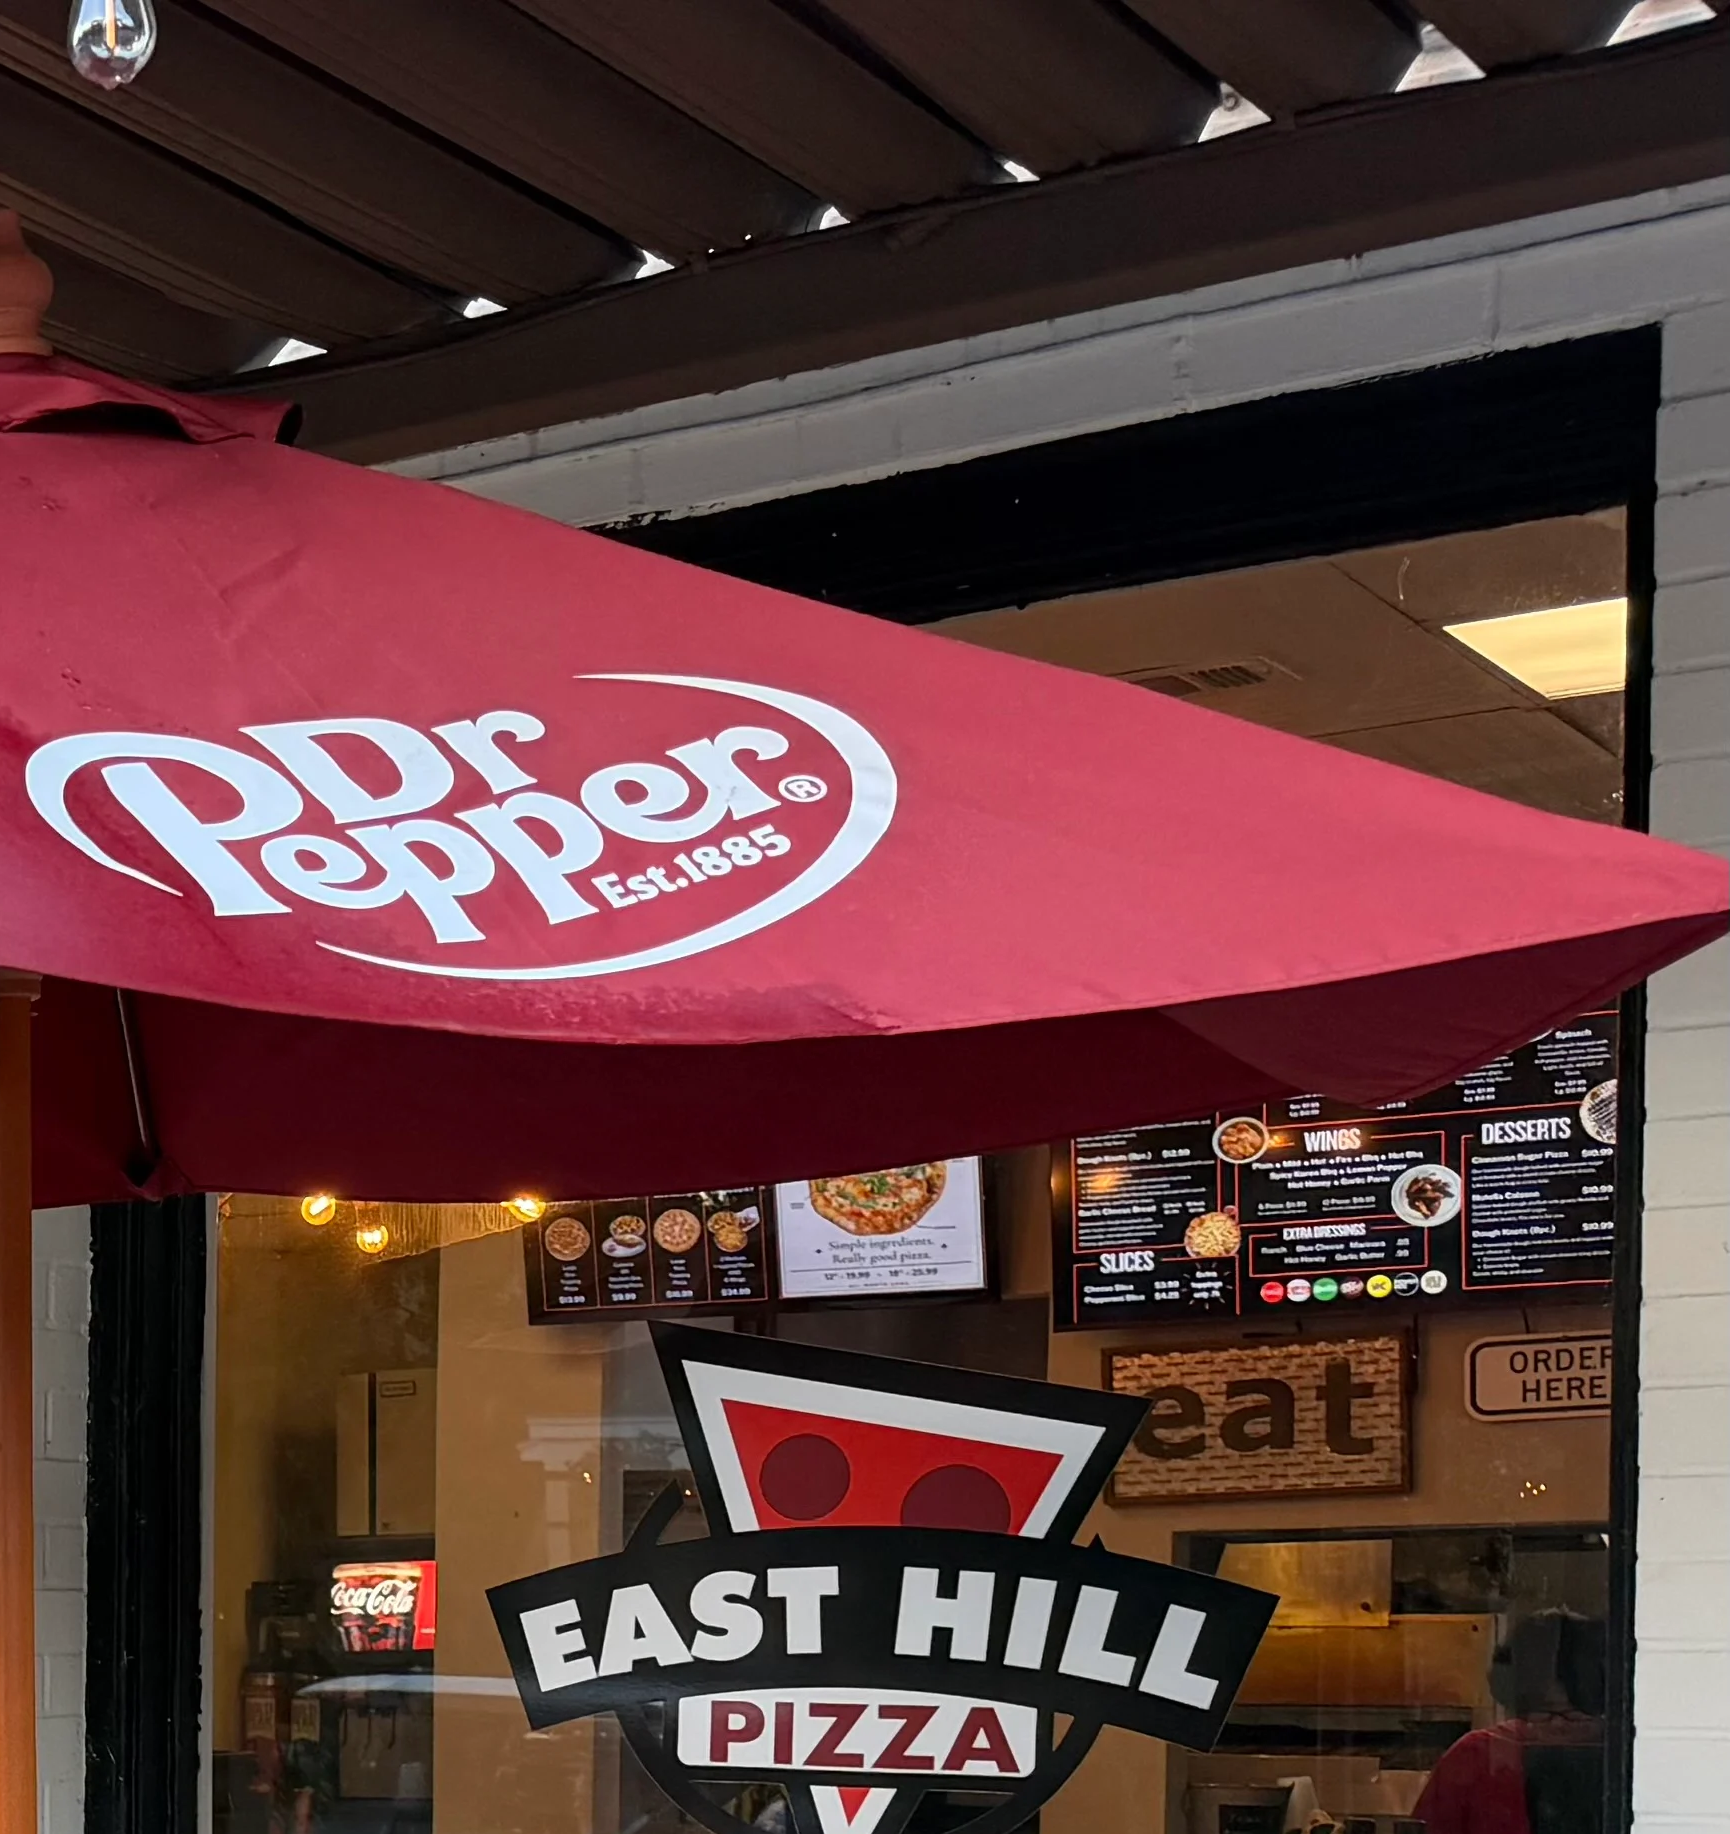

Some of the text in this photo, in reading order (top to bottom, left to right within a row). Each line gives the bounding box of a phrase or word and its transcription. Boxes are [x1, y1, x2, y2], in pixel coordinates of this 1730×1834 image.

[239, 711, 546, 824] Dr
[26, 726, 790, 944] Pepper
[1304, 1128, 1361, 1152] WINGS
[1481, 1117, 1571, 1144] DESSERTS
[829, 1237, 935, 1251] Simple ingredients.
[1283, 1223, 1366, 1241] EXTRA DRESSINGS
[832, 1251, 931, 1265] Really good pizza.
[1100, 1251, 1155, 1274] SLICES
[1522, 1376, 1607, 1402] HERE
[1132, 1356, 1375, 1460] eat
[519, 1565, 1219, 1710] EAST HILL
[708, 1700, 1021, 1773] PIZZA
